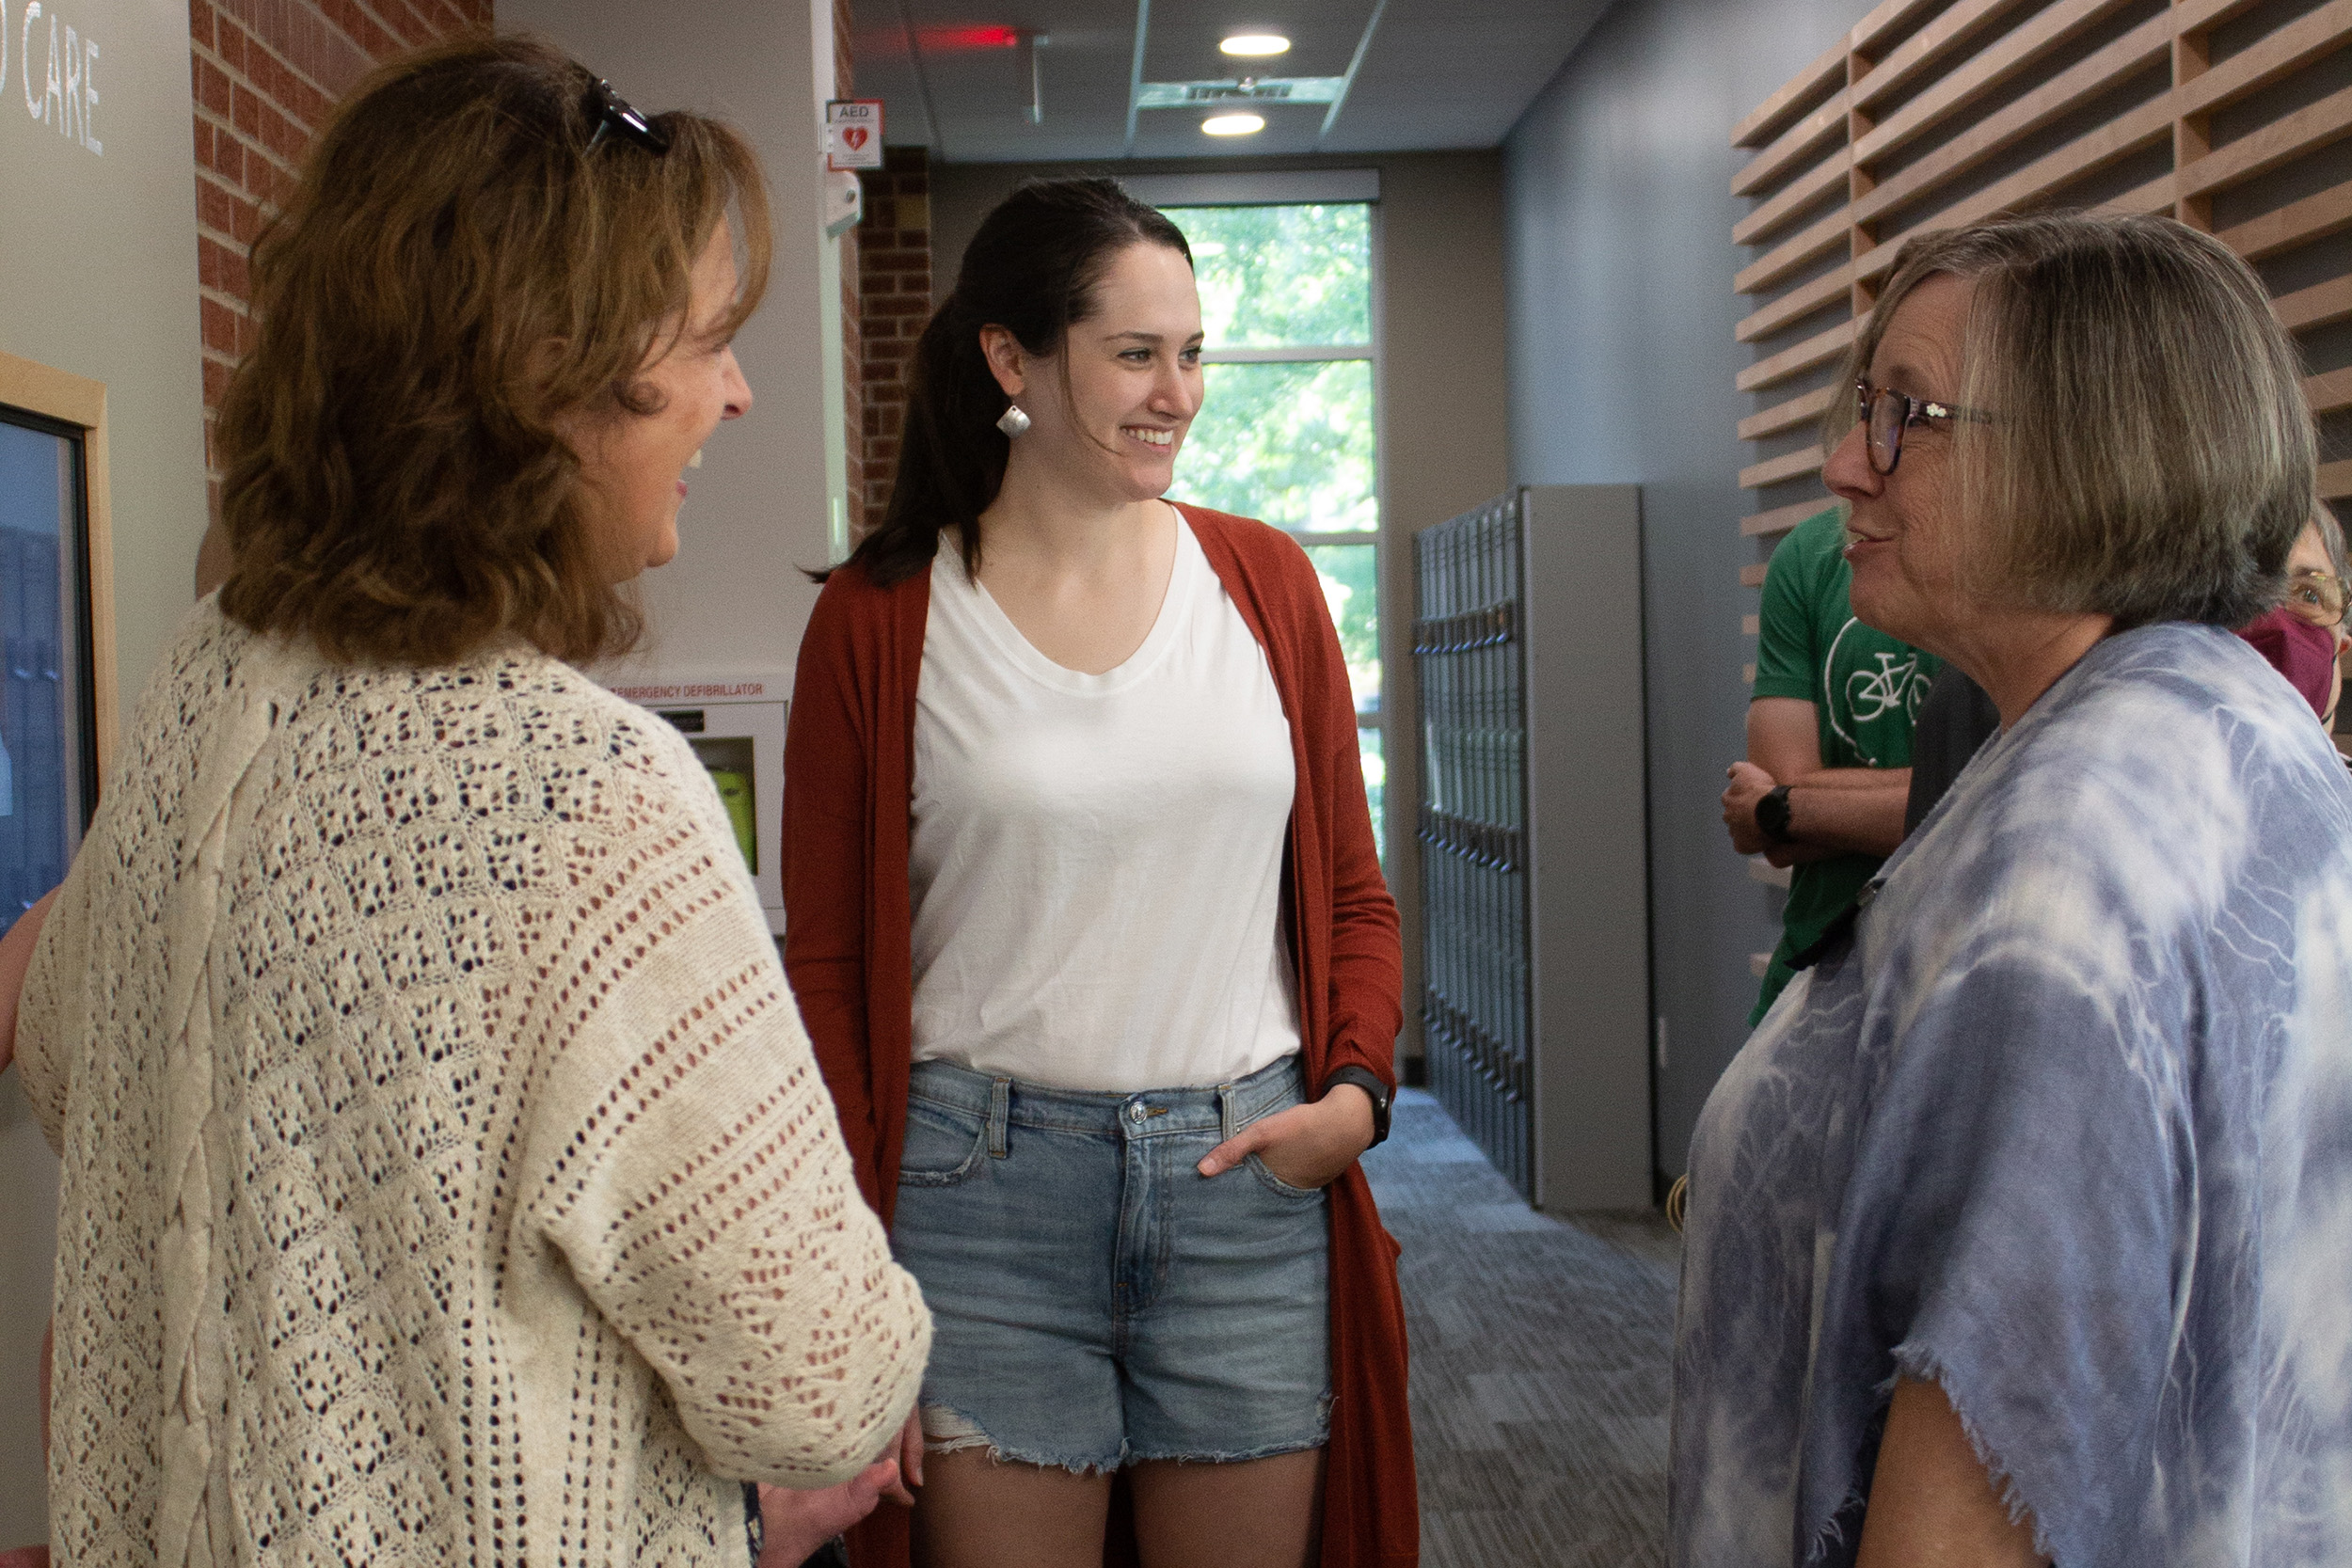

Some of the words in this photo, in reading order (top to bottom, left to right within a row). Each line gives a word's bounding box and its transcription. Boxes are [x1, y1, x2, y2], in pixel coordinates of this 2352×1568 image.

[23, 1, 103, 156] CARE
[839, 105, 869, 118] AED
[617, 685, 681, 700] EMERGENCY
[683, 683, 763, 698] DEFIBRILLATOR
